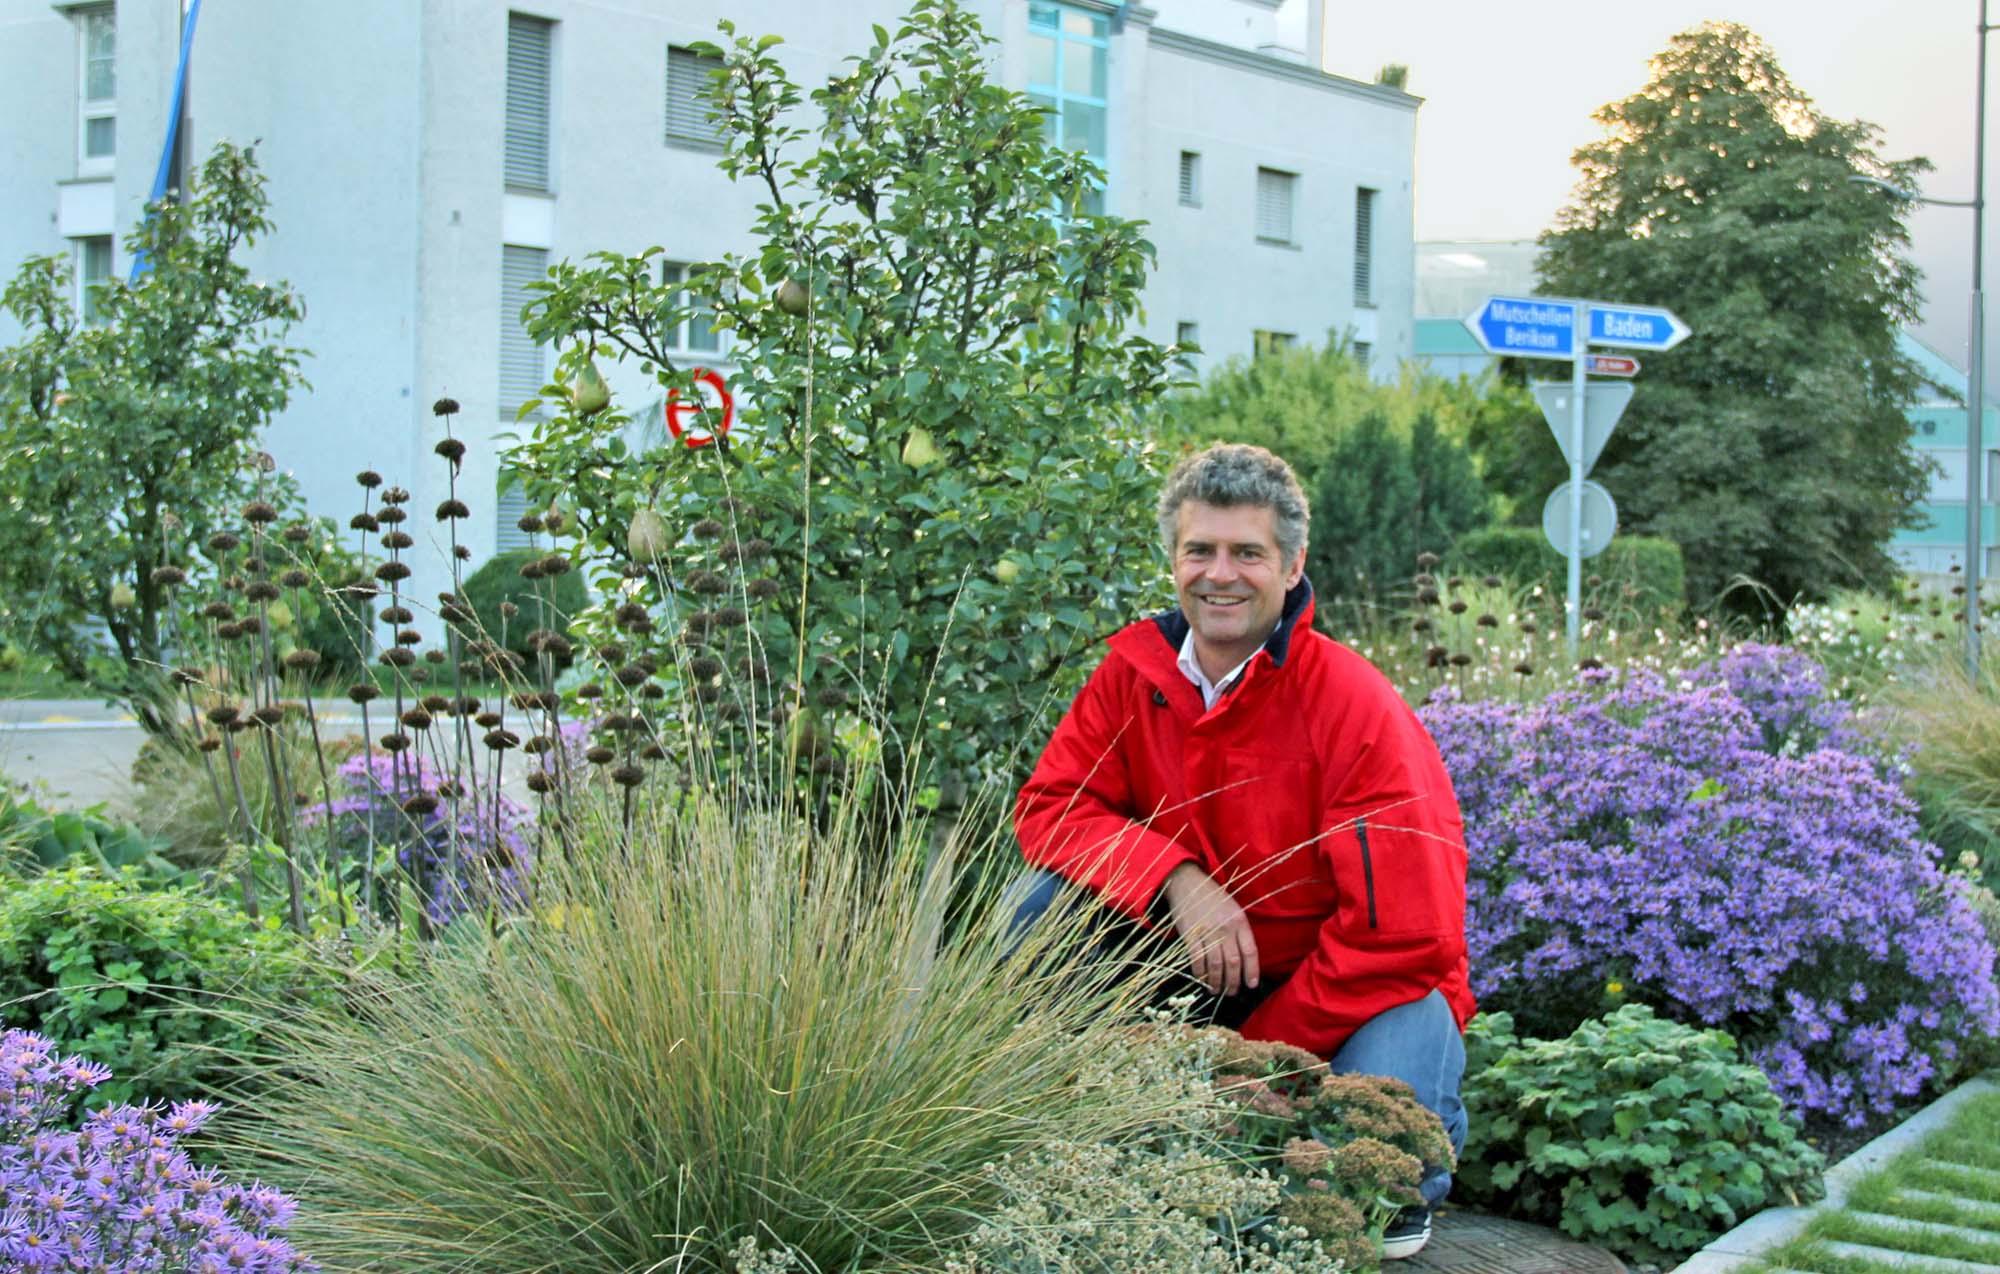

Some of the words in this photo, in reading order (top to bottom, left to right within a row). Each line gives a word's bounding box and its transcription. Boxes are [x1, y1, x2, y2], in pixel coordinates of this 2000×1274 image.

[1491, 302, 1571, 326] Mutschellen
[1604, 314, 1653, 338] Baden
[1505, 327, 1557, 347] Berikon
